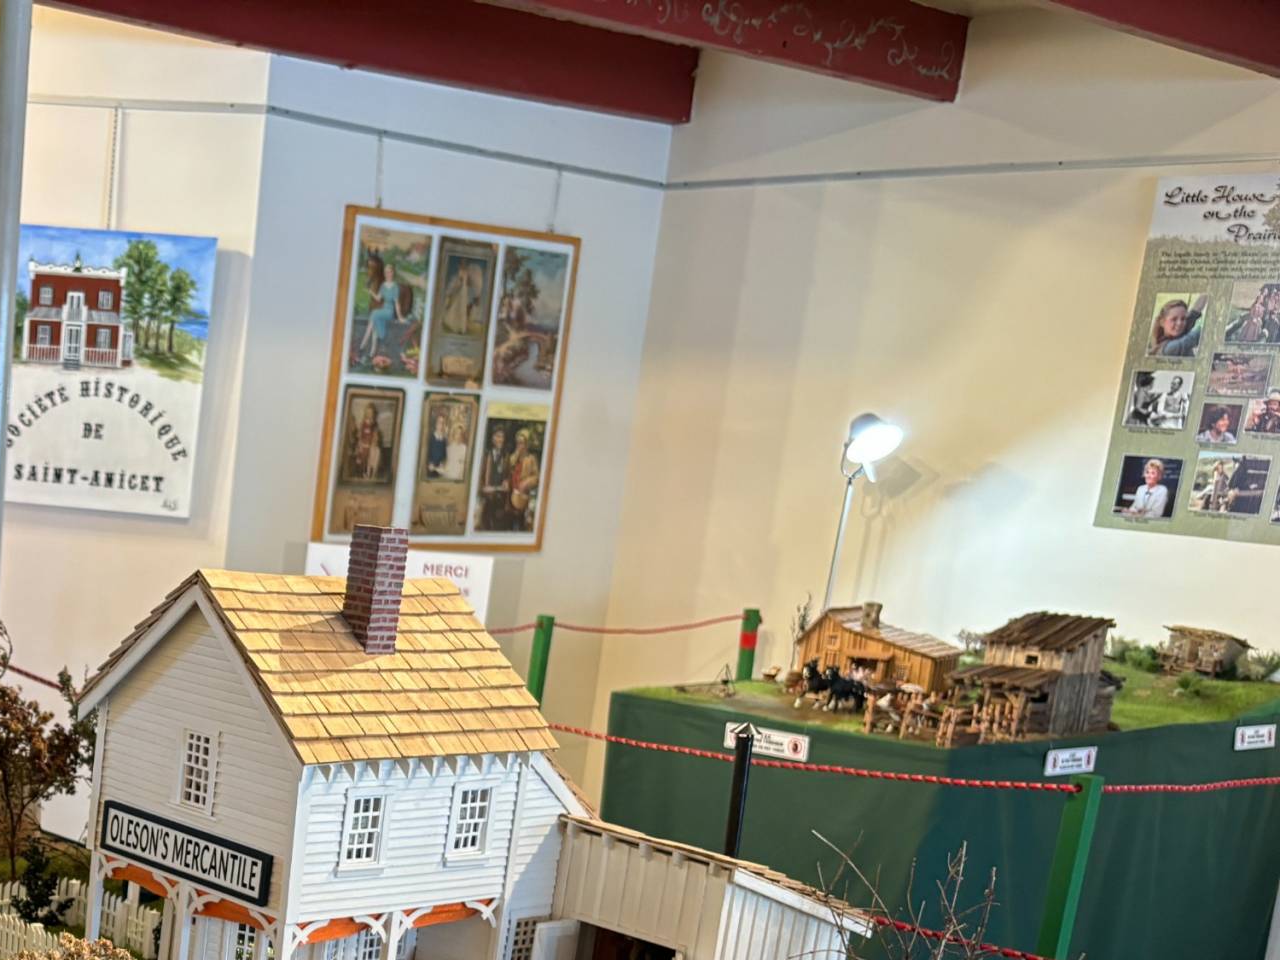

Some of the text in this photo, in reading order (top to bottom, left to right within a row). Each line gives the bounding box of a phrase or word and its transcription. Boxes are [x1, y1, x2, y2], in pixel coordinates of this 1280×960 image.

[1163, 185, 1277, 206] Little House
[1203, 205, 1255, 220] on the
[1227, 223, 1280, 243] Prairi
[80, 377, 187, 461] HISTORIQUE
[82, 422, 104, 439] DE
[14, 462, 165, 493] SAINT-ANICET
[423, 563, 468, 577] MERCI
[110, 814, 258, 891] OLESON'S MERCANTILE
